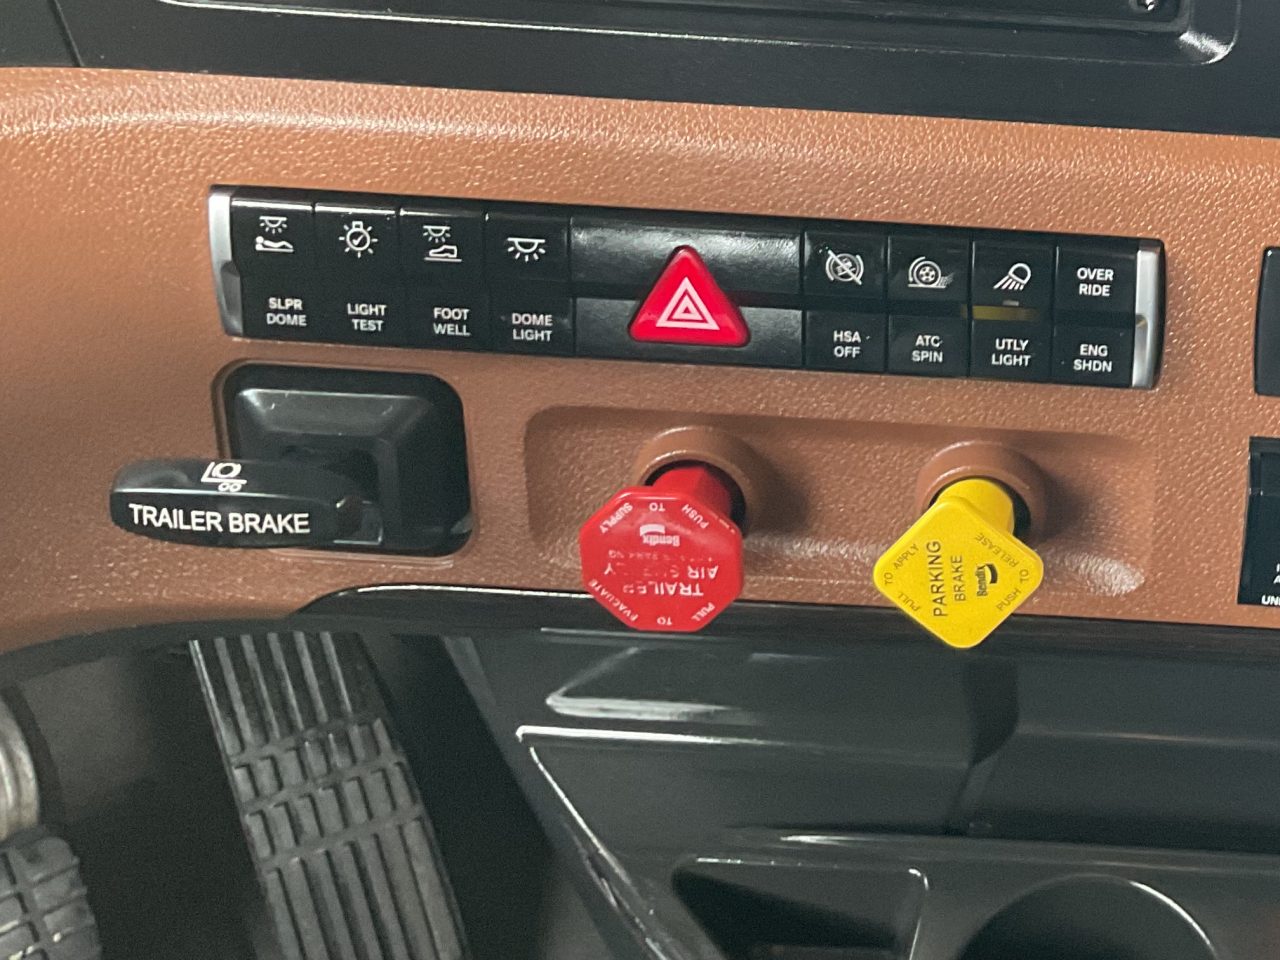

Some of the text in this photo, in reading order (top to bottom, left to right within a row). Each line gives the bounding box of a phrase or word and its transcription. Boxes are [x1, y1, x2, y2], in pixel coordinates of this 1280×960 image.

[1076, 267, 1114, 282] OVER
[1078, 283, 1111, 297] RIDE
[268, 297, 303, 311] SLPR
[347, 303, 387, 317] LIGHT
[265, 312, 307, 328] DOME
[433, 307, 470, 322] FOOT
[511, 312, 553, 327] DOME
[351, 318, 384, 333] TEST
[433, 322, 471, 337] WELL
[512, 327, 553, 342] LIGHT
[833, 330, 862, 344] HSA
[915, 334, 941, 348] ATC
[833, 345, 861, 359] OFF
[994, 338, 1029, 352] UTLY
[1079, 344, 1109, 358] ENG
[912, 349, 943, 363] SPIN
[991, 353, 1032, 368] LIGHT
[1073, 358, 1113, 373] SHDN
[128, 503, 310, 534] TRAILER BRAKE
[600, 502, 709, 534] PUSH TO SUPPLY
[642, 534, 680, 547] Bendix
[884, 572, 893, 585] TO
[894, 543, 920, 570] APPLY
[687, 565, 719, 579] AIR
[926, 540, 948, 617] PARKING
[950, 555, 966, 602] BRAKE
[975, 533, 1030, 611] PUSH TO RELEASE
[975, 565, 988, 597] Bendix
[691, 602, 716, 622] PULL
[657, 616, 672, 626] TO
